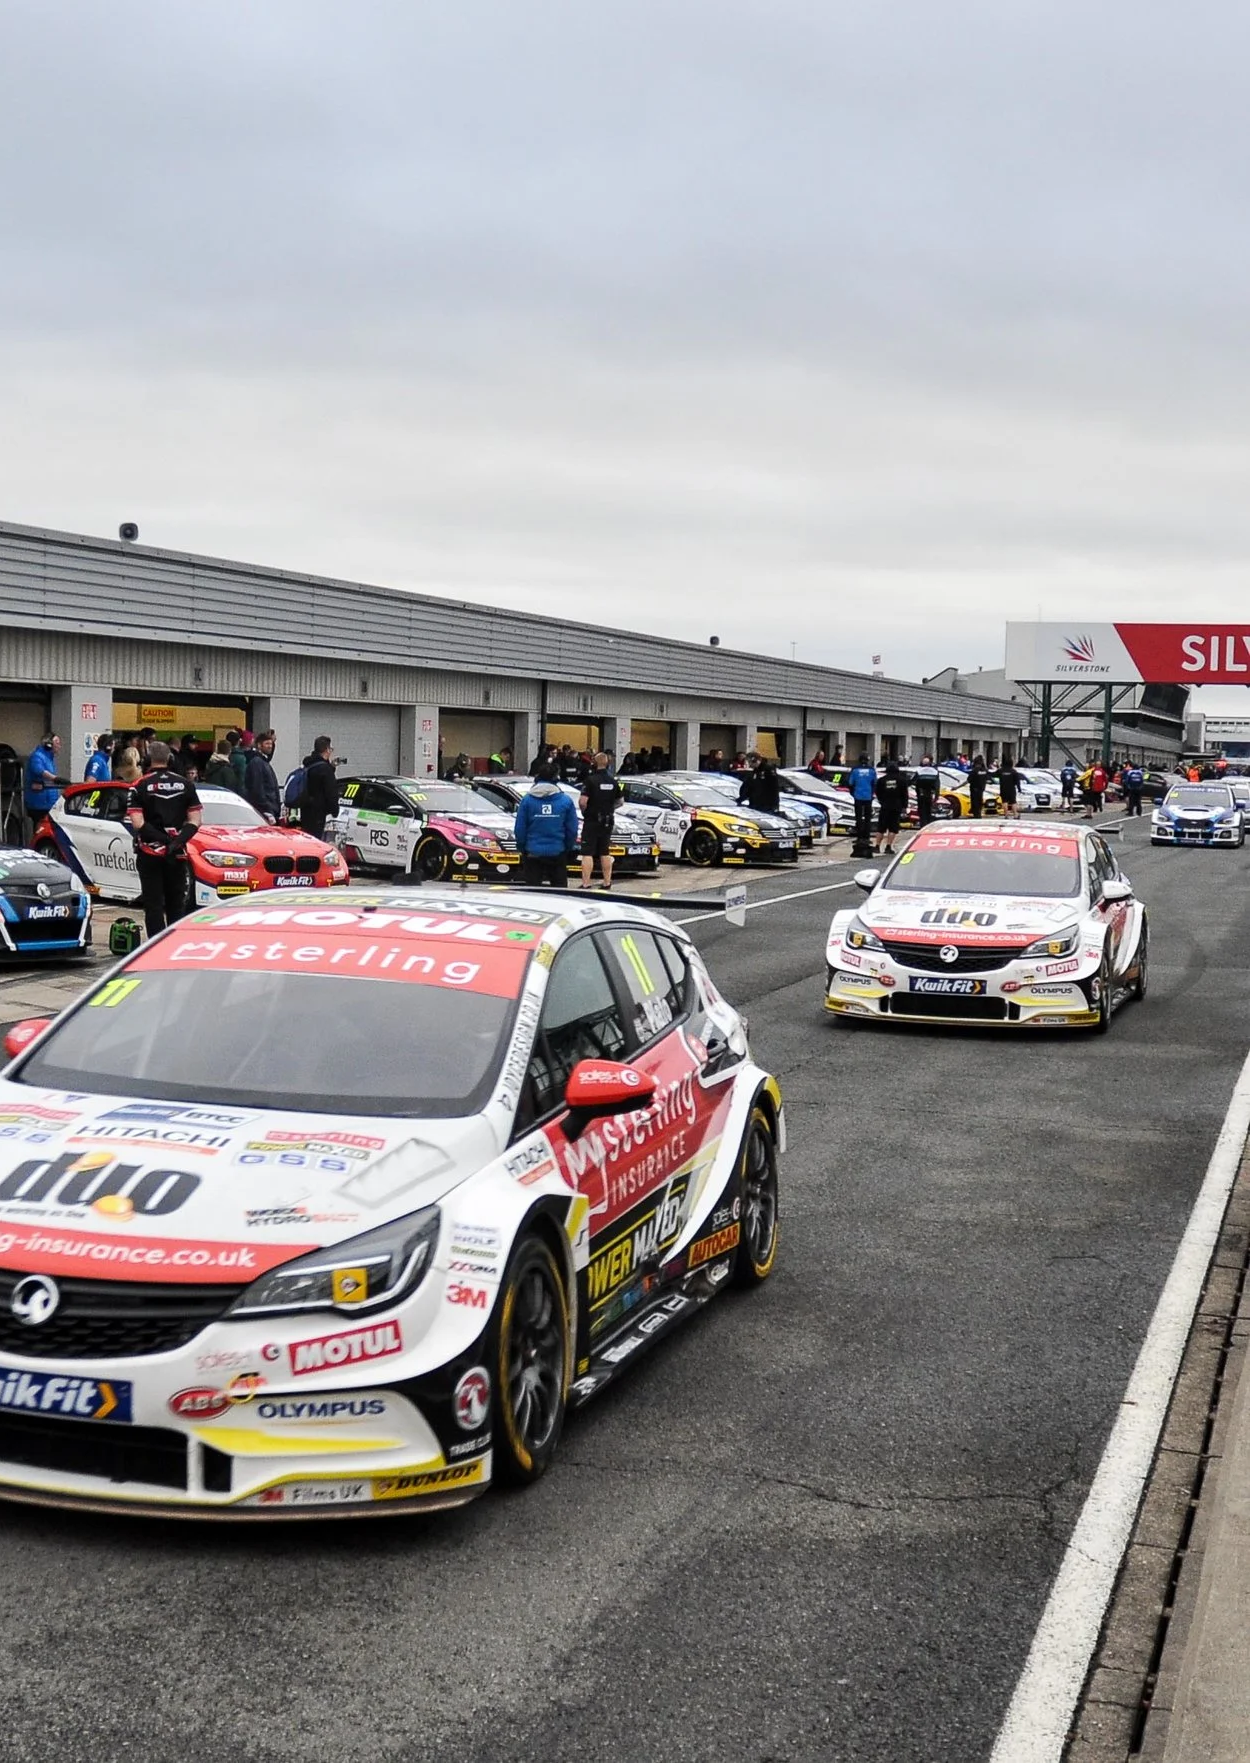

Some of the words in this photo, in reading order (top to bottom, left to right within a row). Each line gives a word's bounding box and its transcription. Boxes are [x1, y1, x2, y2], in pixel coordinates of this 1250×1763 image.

[1181, 635, 1250, 671] SIL
[1055, 665, 1111, 673] SILVERSTONE
[143, 708, 174, 717] CAUTION
[955, 836, 1061, 855] sterling
[212, 910, 503, 943] MOTUL
[920, 908, 998, 926] duo
[897, 928, 1028, 943] sterling-insurance.co.uk
[230, 941, 481, 985] sterling
[621, 933, 655, 995] 11
[1048, 960, 1078, 976] MOTUL
[839, 975, 872, 985] OLYMPUS
[1030, 986, 1073, 994] OLYMPUS
[88, 978, 142, 1007] 11
[185, 1112, 245, 1124] BTCC
[76, 1126, 231, 1148] HITACHI
[691, 1226, 740, 1264] AUTOCAR
[447, 1284, 488, 1310] 3M
[294, 1326, 399, 1373] MOTUL
[258, 1399, 386, 1419] OLYMPUS
[395, 1464, 479, 1490] DUNLOP
[292, 1487, 335, 1501] Films
[339, 1484, 363, 1498] UK
